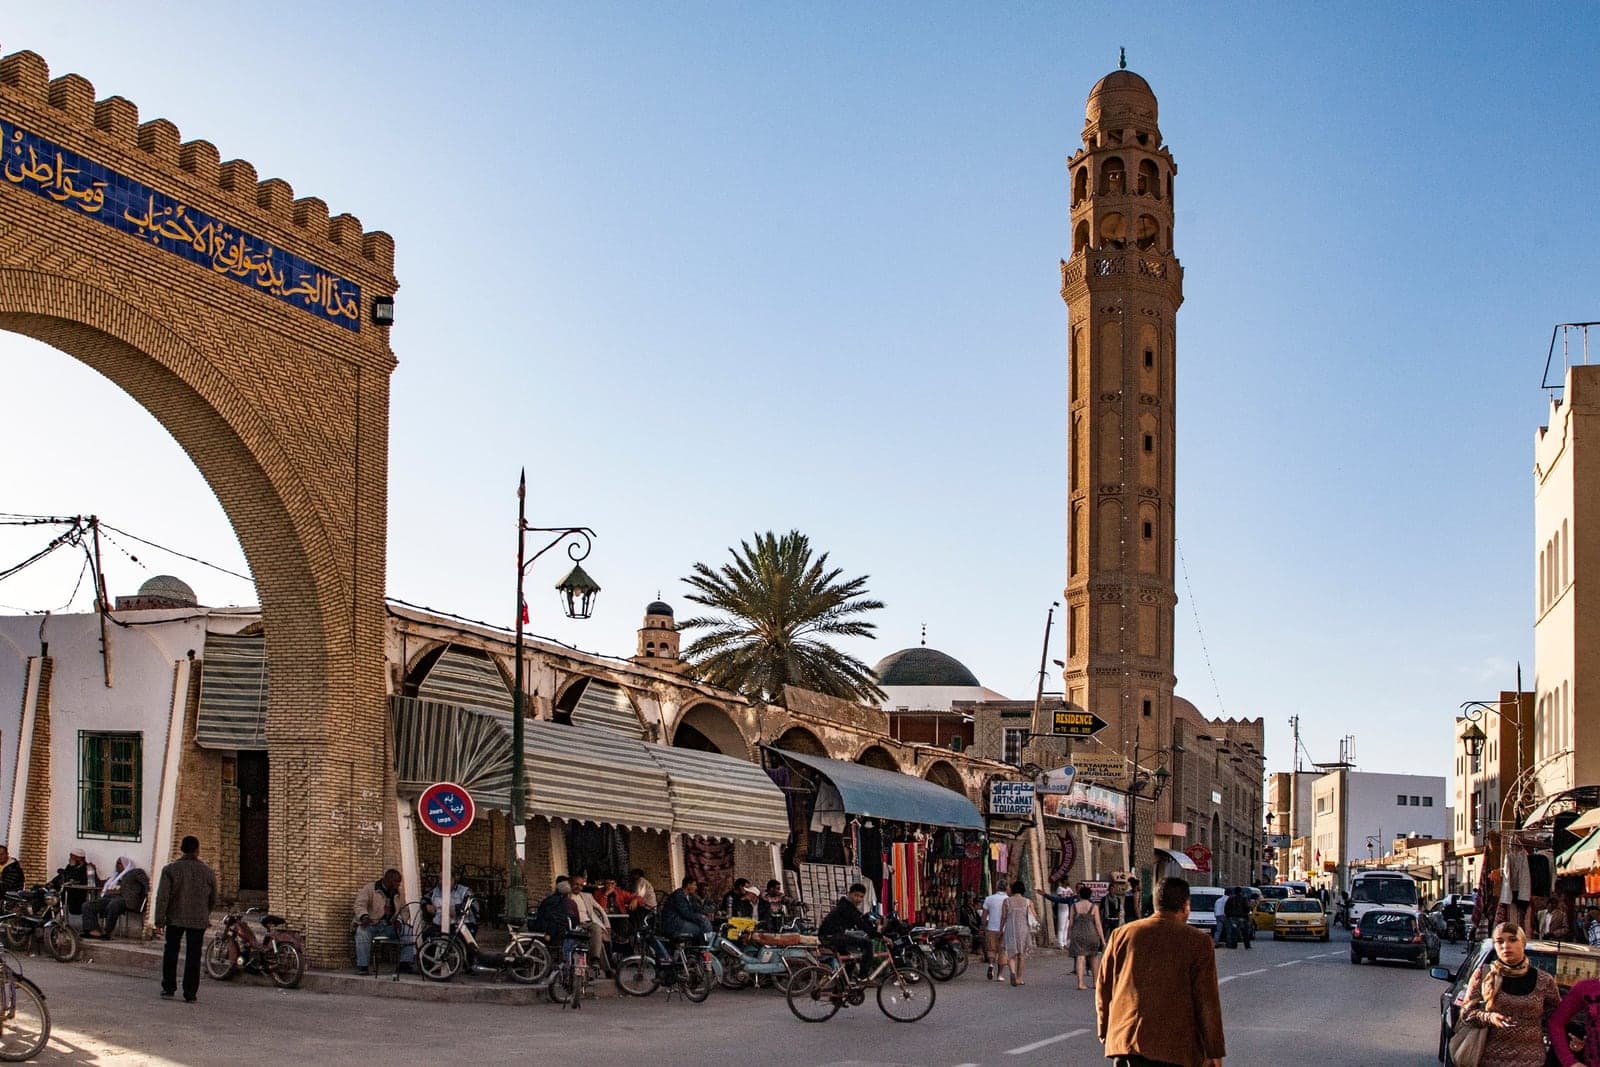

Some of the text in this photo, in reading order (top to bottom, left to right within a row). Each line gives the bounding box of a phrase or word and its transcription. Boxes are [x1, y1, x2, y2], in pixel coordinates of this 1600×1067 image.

[1055, 713, 1094, 725] RESIDENCE
[992, 795, 1033, 805] ARTISANAT
[994, 804, 1033, 813] TOUAREG
[1376, 914, 1401, 925] Clio
